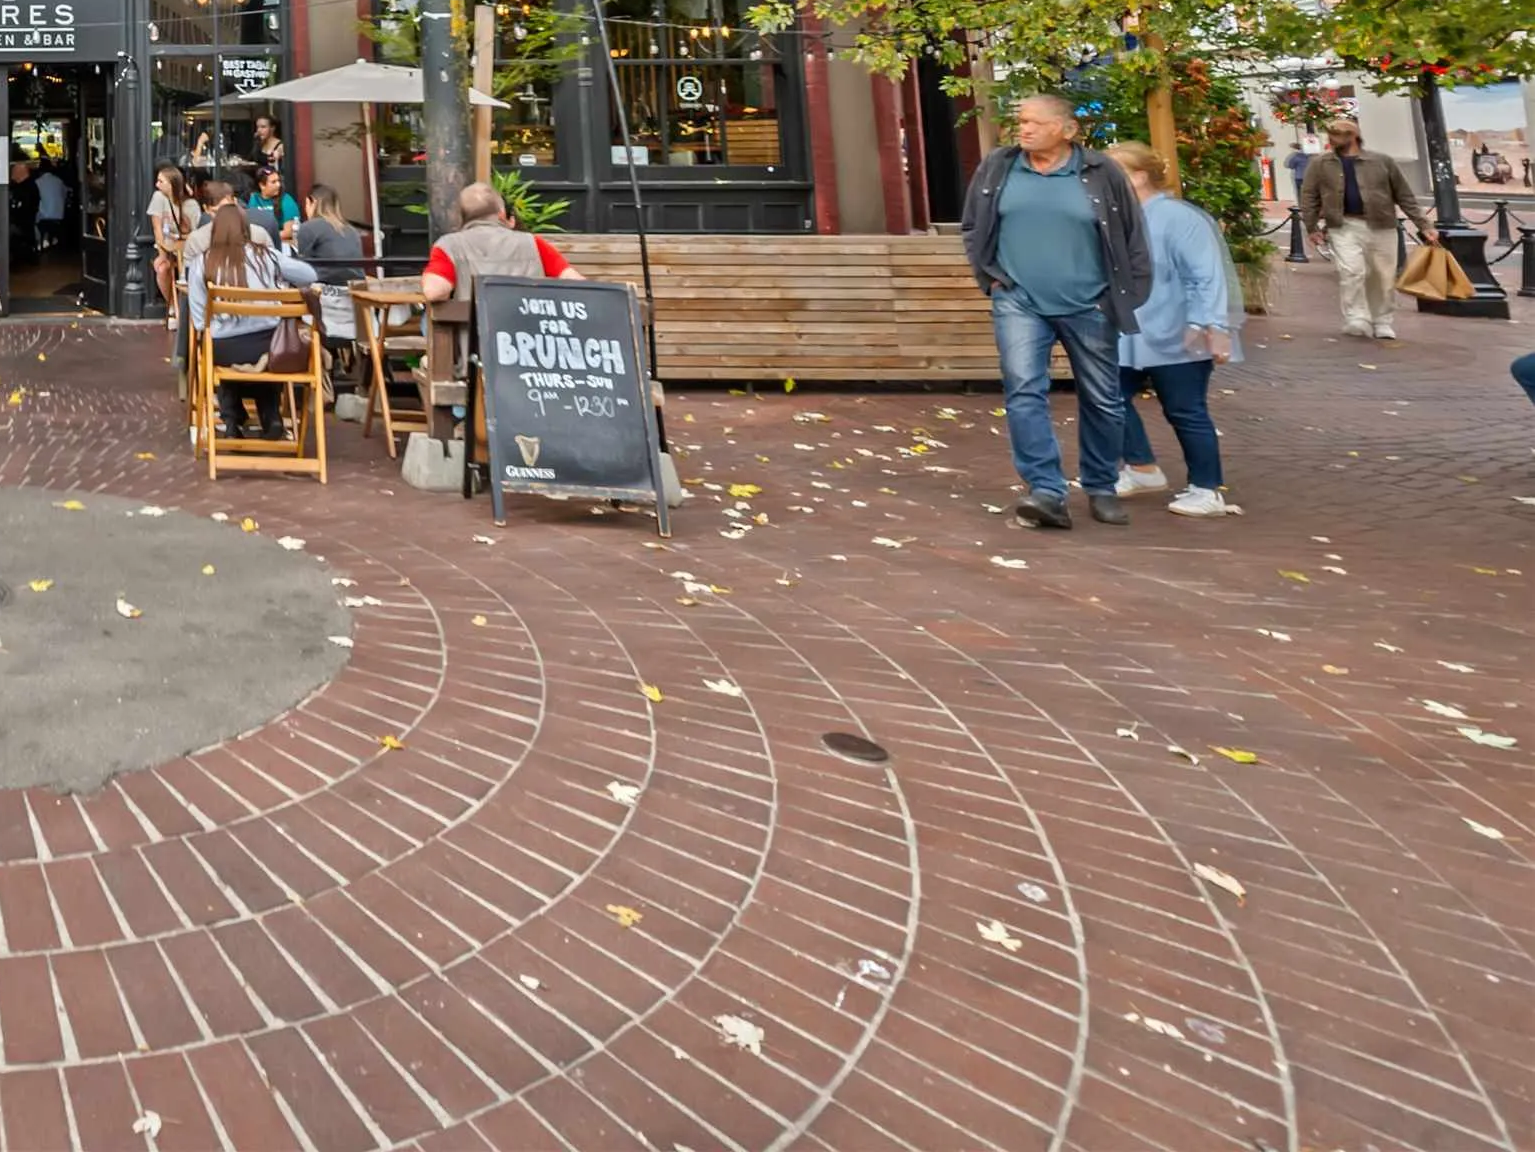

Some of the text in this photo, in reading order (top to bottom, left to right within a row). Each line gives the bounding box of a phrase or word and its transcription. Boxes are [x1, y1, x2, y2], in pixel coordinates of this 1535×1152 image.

[23, 34, 34, 46] &
[43, 34, 75, 46] BAR
[518, 297, 588, 321] JOIN US
[538, 319, 572, 336] FOR
[496, 331, 626, 375] BRUNCH
[505, 464, 556, 479] GUINNESS
